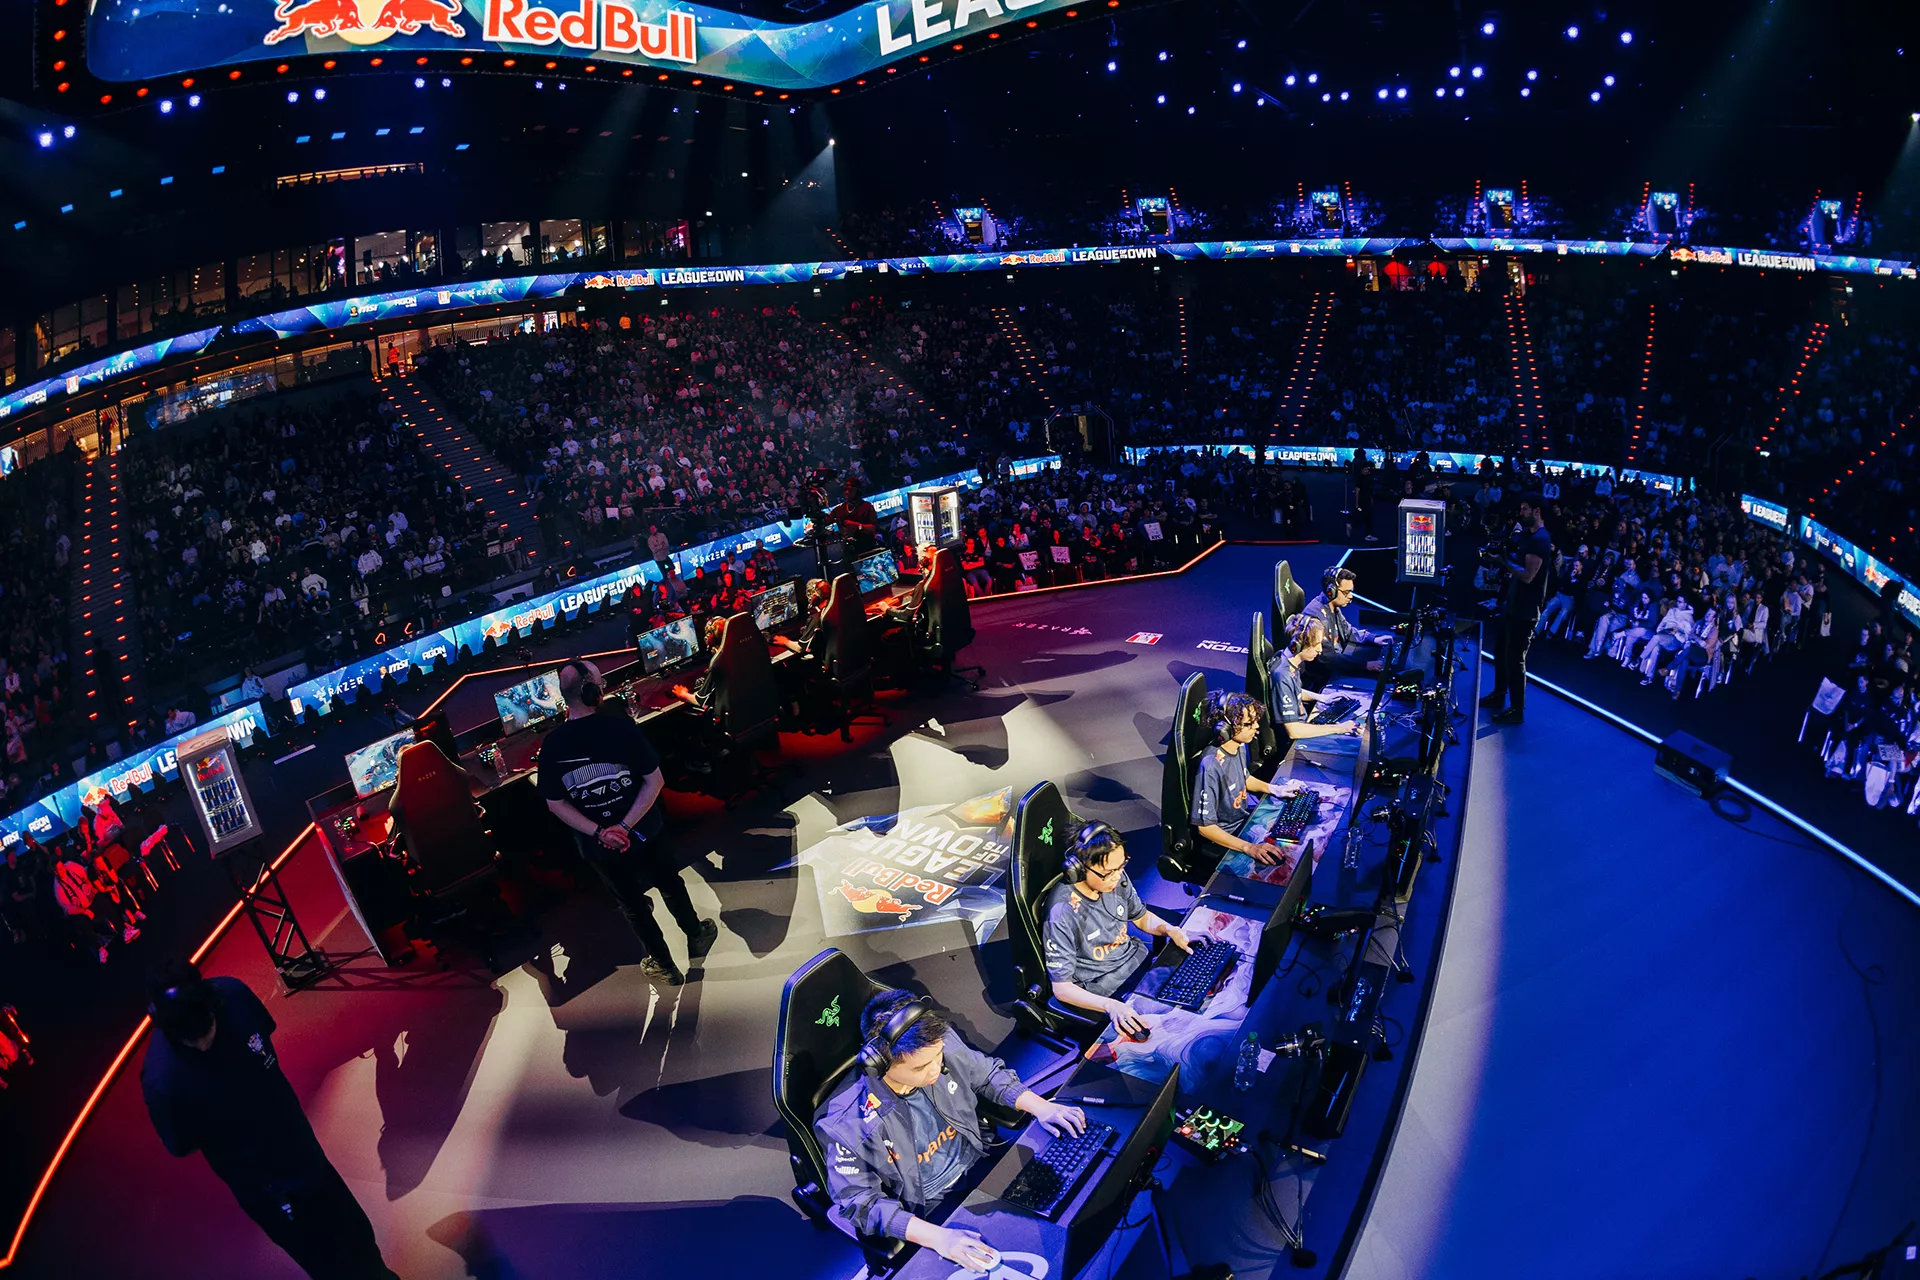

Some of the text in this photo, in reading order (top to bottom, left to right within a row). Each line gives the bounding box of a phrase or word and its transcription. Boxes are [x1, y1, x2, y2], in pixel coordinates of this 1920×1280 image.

[603, 4, 695, 62] Bull
[876, 0, 1045, 56] LEA
[1072, 250, 1119, 262] LEAGUE
[1127, 248, 1157, 259] OWN
[1738, 253, 1781, 269] LEAGUE
[661, 271, 708, 285] LEAGUE
[715, 269, 744, 282] OWN
